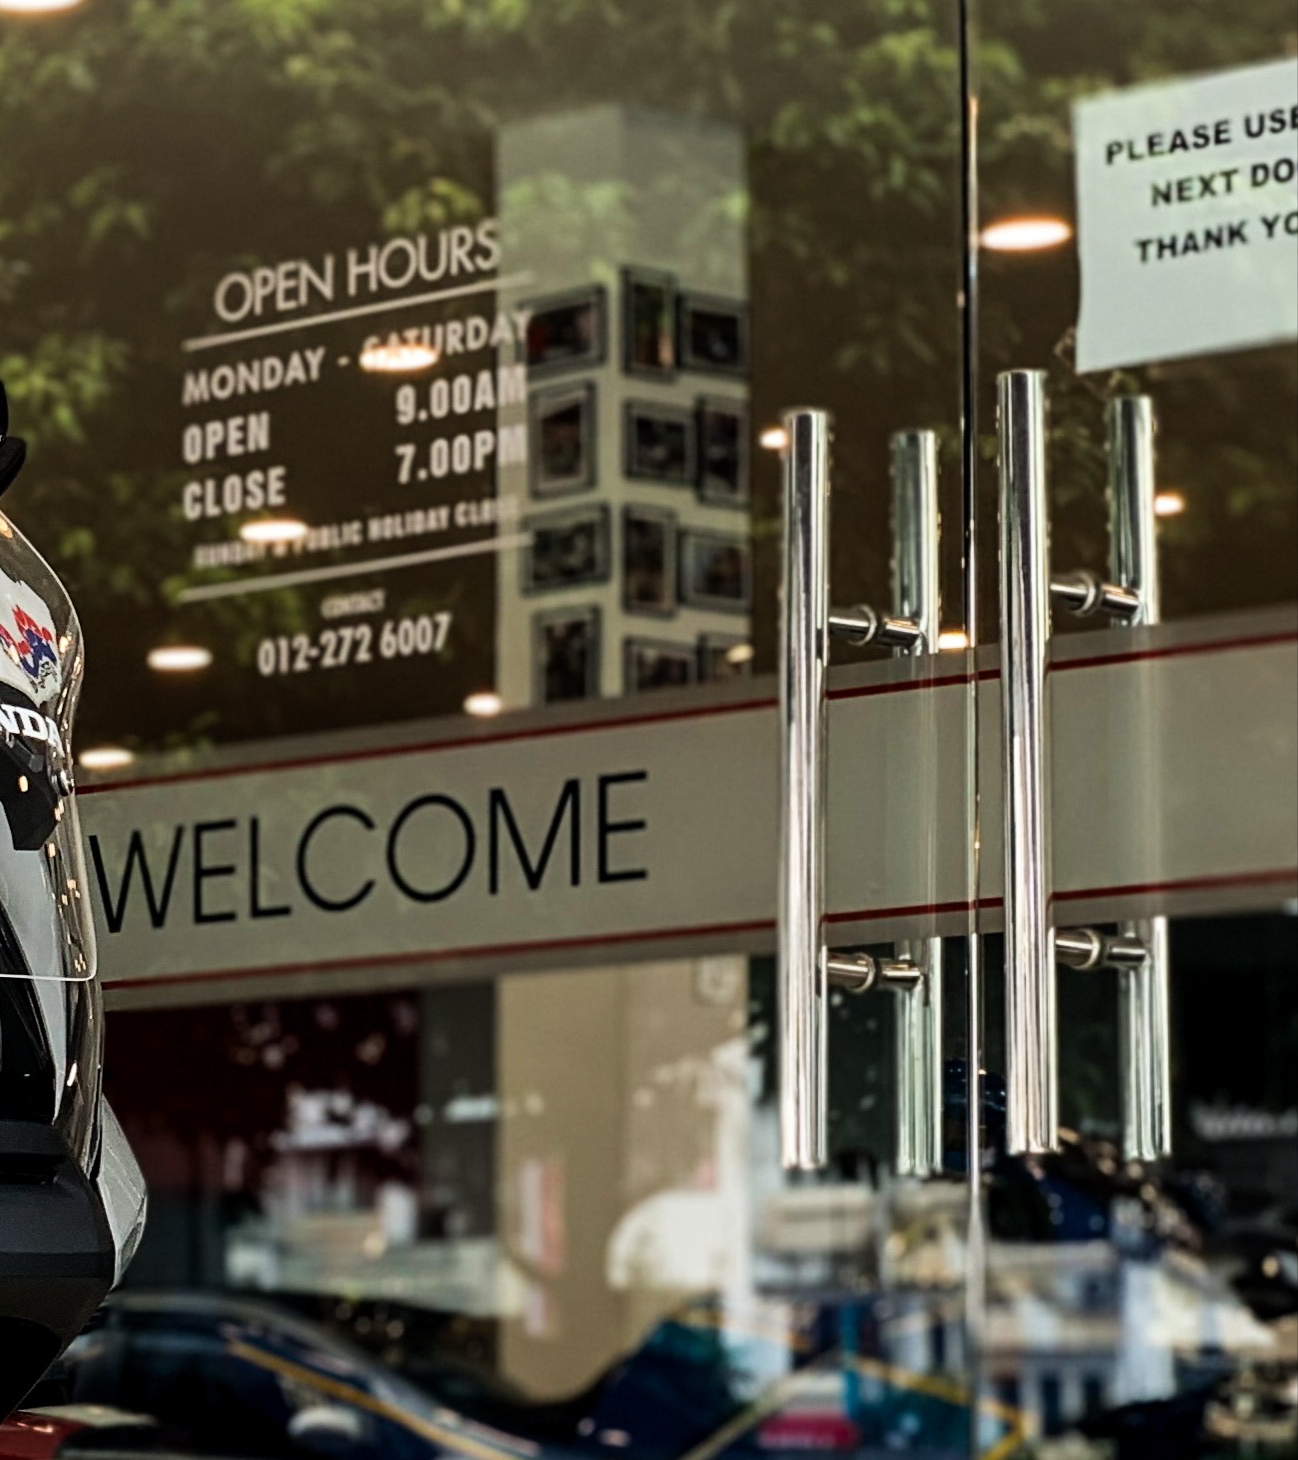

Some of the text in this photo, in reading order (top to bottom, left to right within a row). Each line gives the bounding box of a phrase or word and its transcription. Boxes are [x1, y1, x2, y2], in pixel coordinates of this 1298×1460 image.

[1106, 118, 1232, 165] PLEASE
[1151, 157, 1298, 207] NEXT DO
[214, 219, 501, 322] OPEN HOURS
[1136, 220, 1249, 264] THANK
[182, 347, 325, 407] MONDAY
[183, 363, 527, 463] OPEN 9.00AM
[183, 423, 527, 521] CLOSE 7.00PM
[257, 612, 453, 677] 012-272 6007
[88, 770, 648, 934] WELCOME
